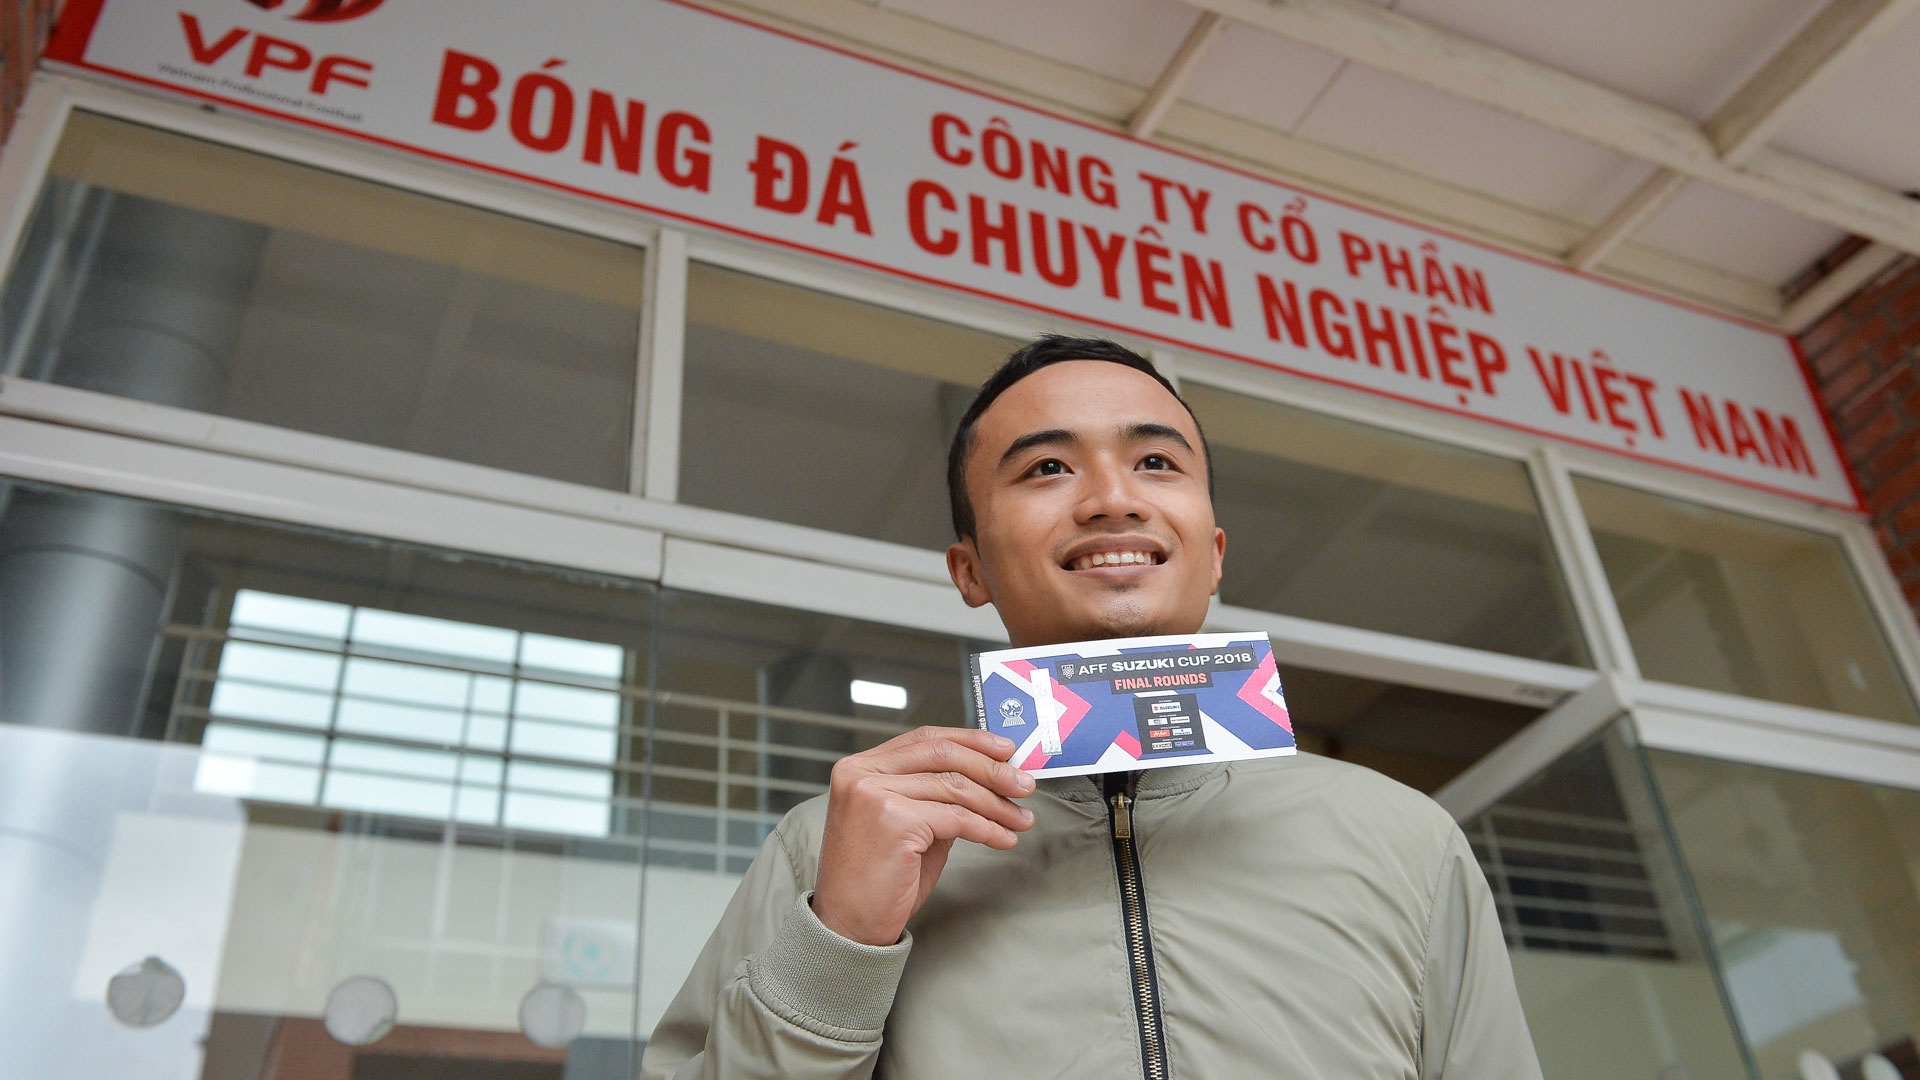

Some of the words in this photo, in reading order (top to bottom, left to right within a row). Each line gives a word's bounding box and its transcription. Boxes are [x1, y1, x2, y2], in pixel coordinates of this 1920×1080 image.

[178, 11, 374, 96] VPF
[931, 112, 1119, 210] CÔNG
[1138, 171, 1212, 234] TY
[1236, 195, 1320, 266] CỔ
[431, 48, 712, 194] BÓNG
[747, 139, 874, 237] ĐÁ
[906, 178, 1234, 330] CHUYÊN
[1255, 273, 1509, 406] NGHIỆP
[1526, 346, 1665, 447] VIỆT
[1679, 388, 1817, 478] NAM
[1077, 663, 1108, 676] AFF
[1111, 657, 1175, 672] SUZUKI
[1177, 654, 1212, 667] CUP
[1214, 652, 1252, 665] 2018
[1114, 676, 1153, 691] FINAL
[1153, 672, 1208, 687] ROUNDS
